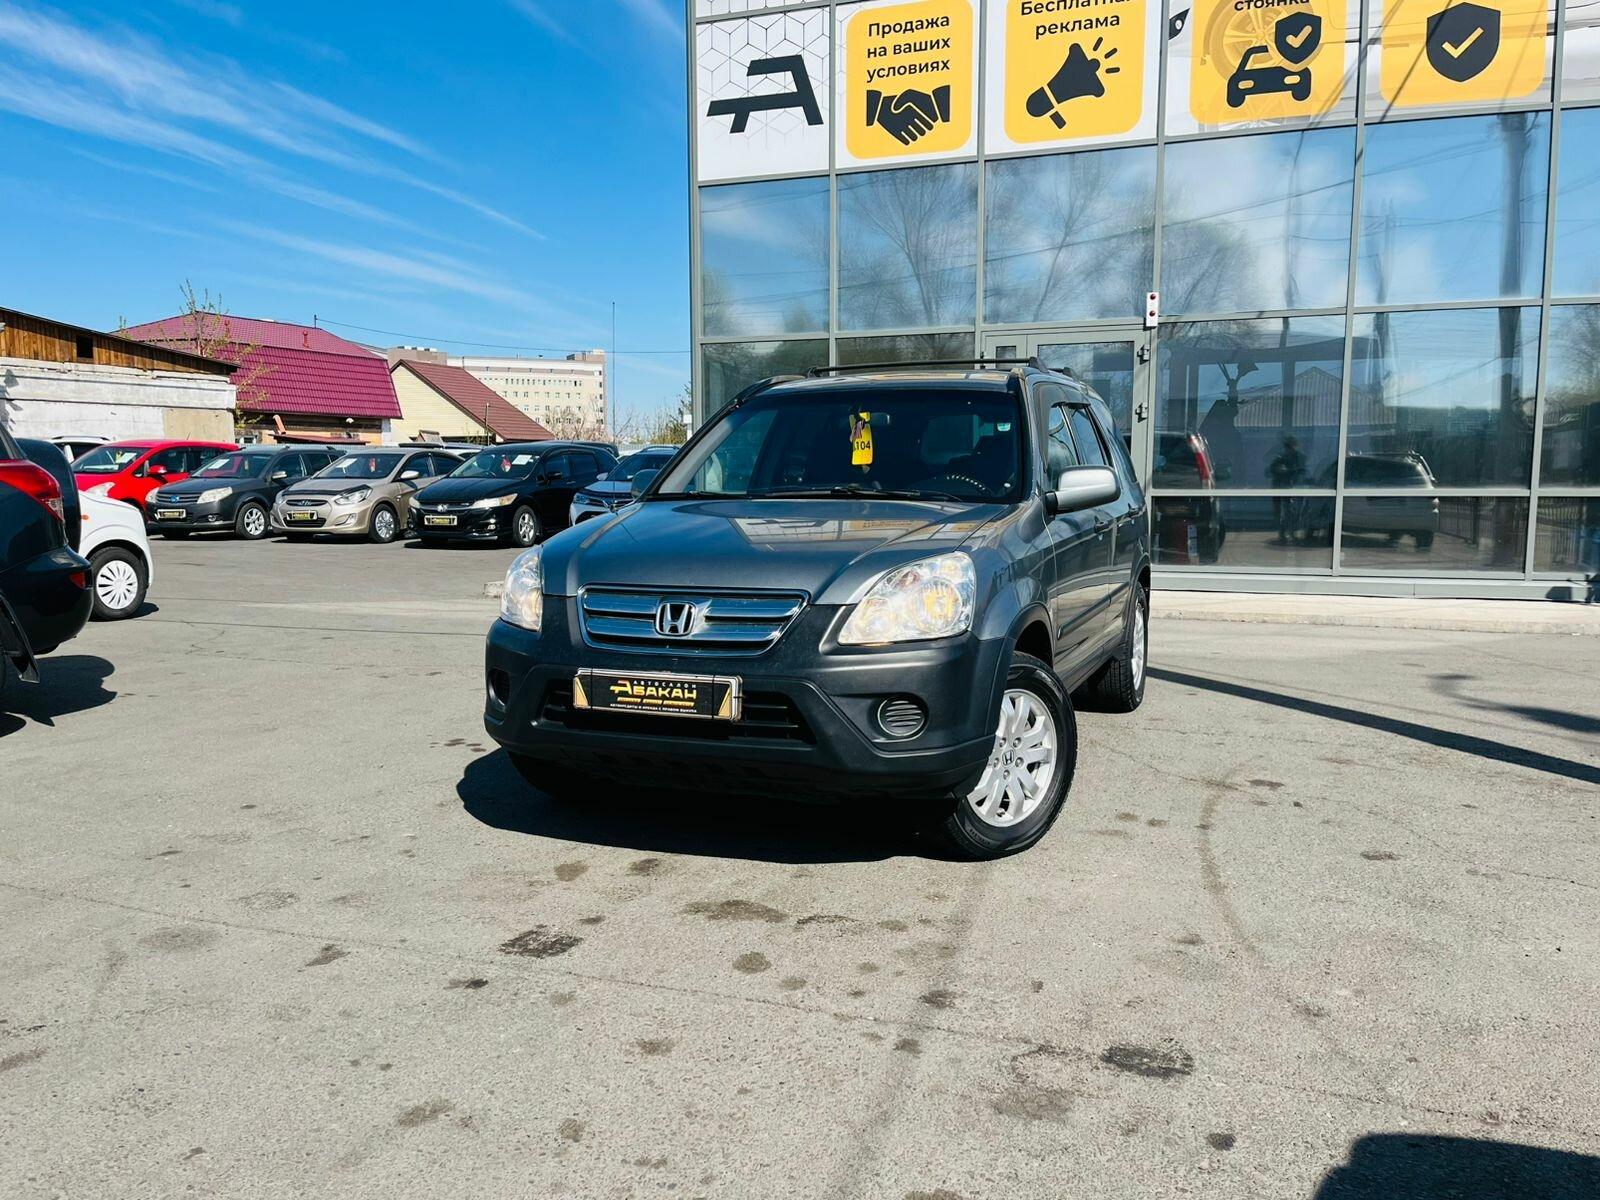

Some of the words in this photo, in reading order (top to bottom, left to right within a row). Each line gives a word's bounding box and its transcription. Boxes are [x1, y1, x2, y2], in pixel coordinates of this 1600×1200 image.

[1021, 0, 1130, 15] Бесплат
[868, 15, 950, 39] Продажа
[1035, 15, 1120, 40] реклама
[867, 45, 887, 58] на
[893, 37, 951, 55] ваших
[866, 59, 950, 83] условиях
